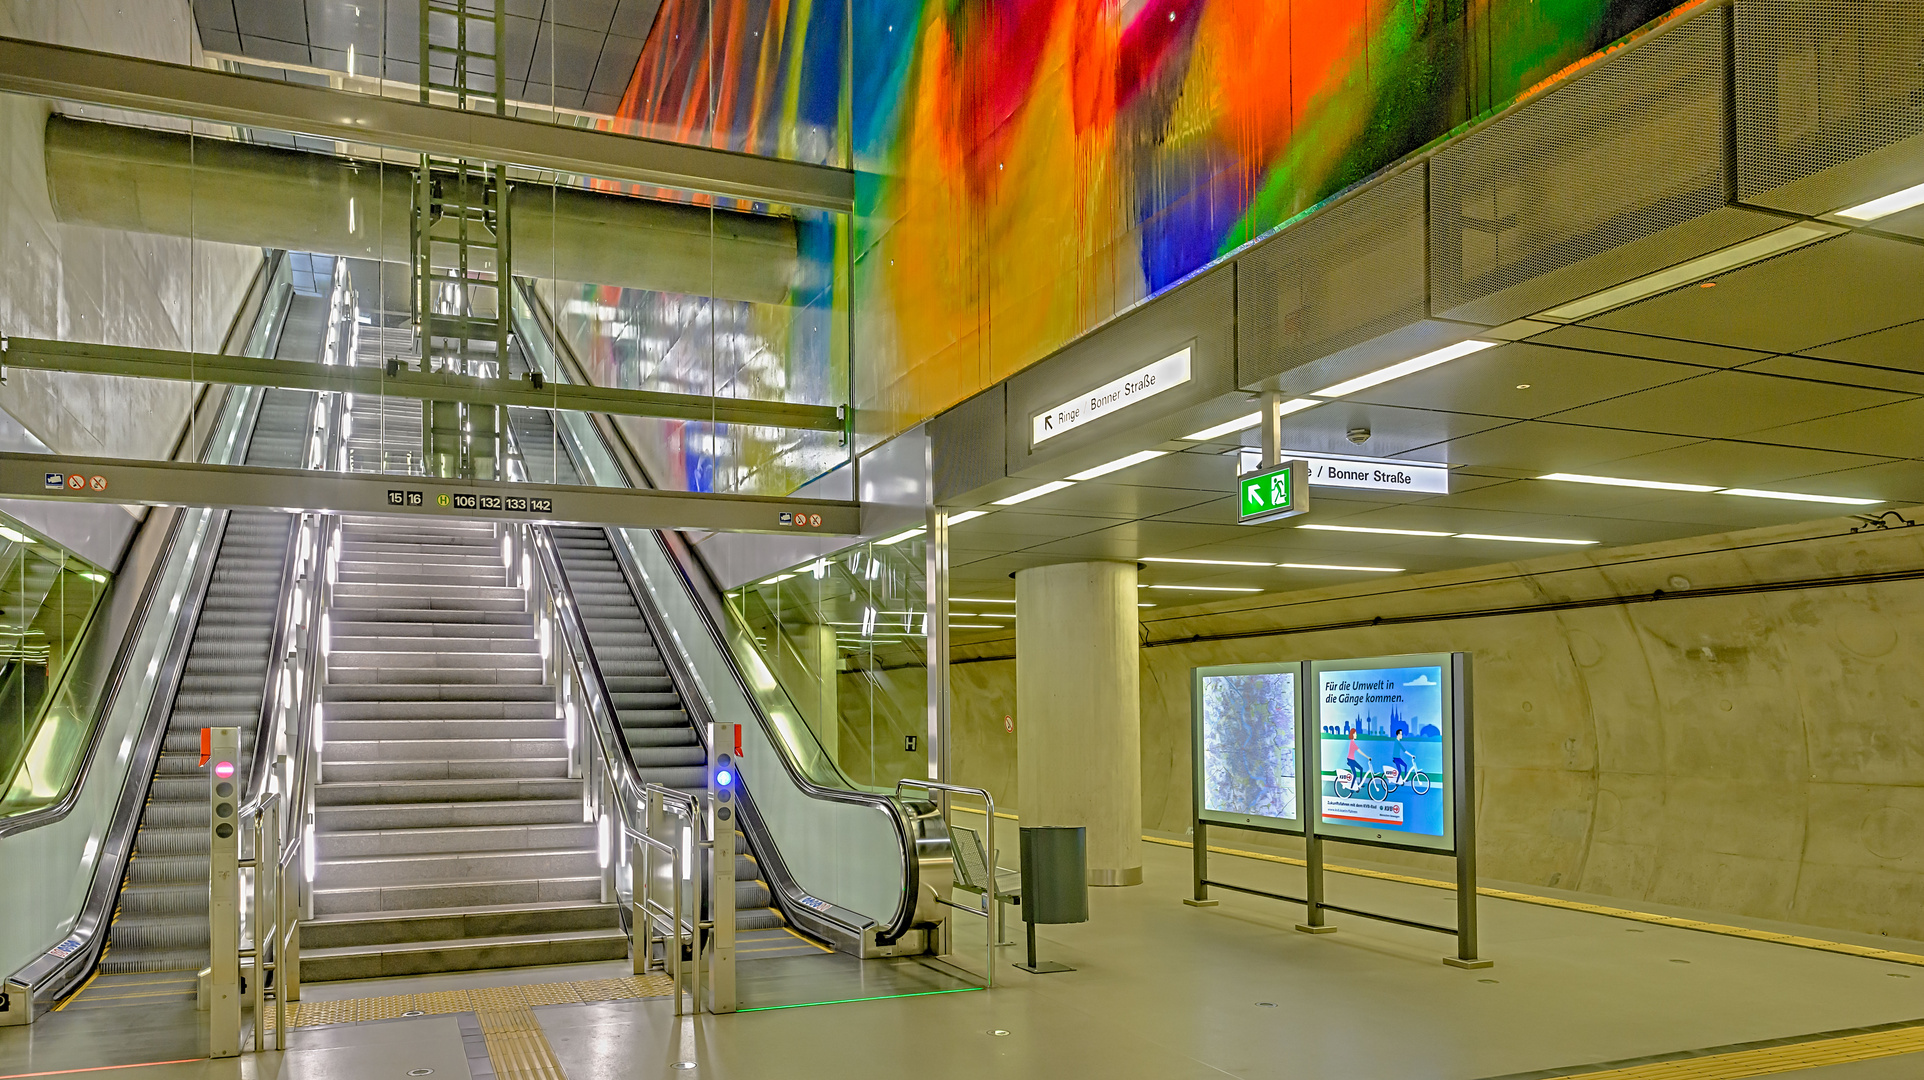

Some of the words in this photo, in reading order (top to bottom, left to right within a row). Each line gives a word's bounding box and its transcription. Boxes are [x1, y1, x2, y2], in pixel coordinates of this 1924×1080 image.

[1058, 408, 1080, 424] Ringe
[1090, 390, 1121, 410] Bonner
[1124, 374, 1156, 396] Straße
[1328, 467, 1369, 480] Bonner
[1373, 470, 1411, 484] Straße
[389, 492, 402, 503] 15
[408, 493, 421, 504] 16
[439, 495, 448, 506] H
[454, 496, 475, 507] 106
[480, 497, 500, 508] 132
[506, 499, 526, 510] 133
[531, 500, 551, 511] 142
[1325, 682, 1337, 691] Für
[1339, 681, 1350, 691] die
[1352, 680, 1384, 690] Umwelt
[1386, 680, 1394, 690] in
[1325, 694, 1337, 703] die
[1338, 693, 1364, 706] Gänge
[1365, 693, 1404, 703] kommen.
[905, 736, 916, 750] H
